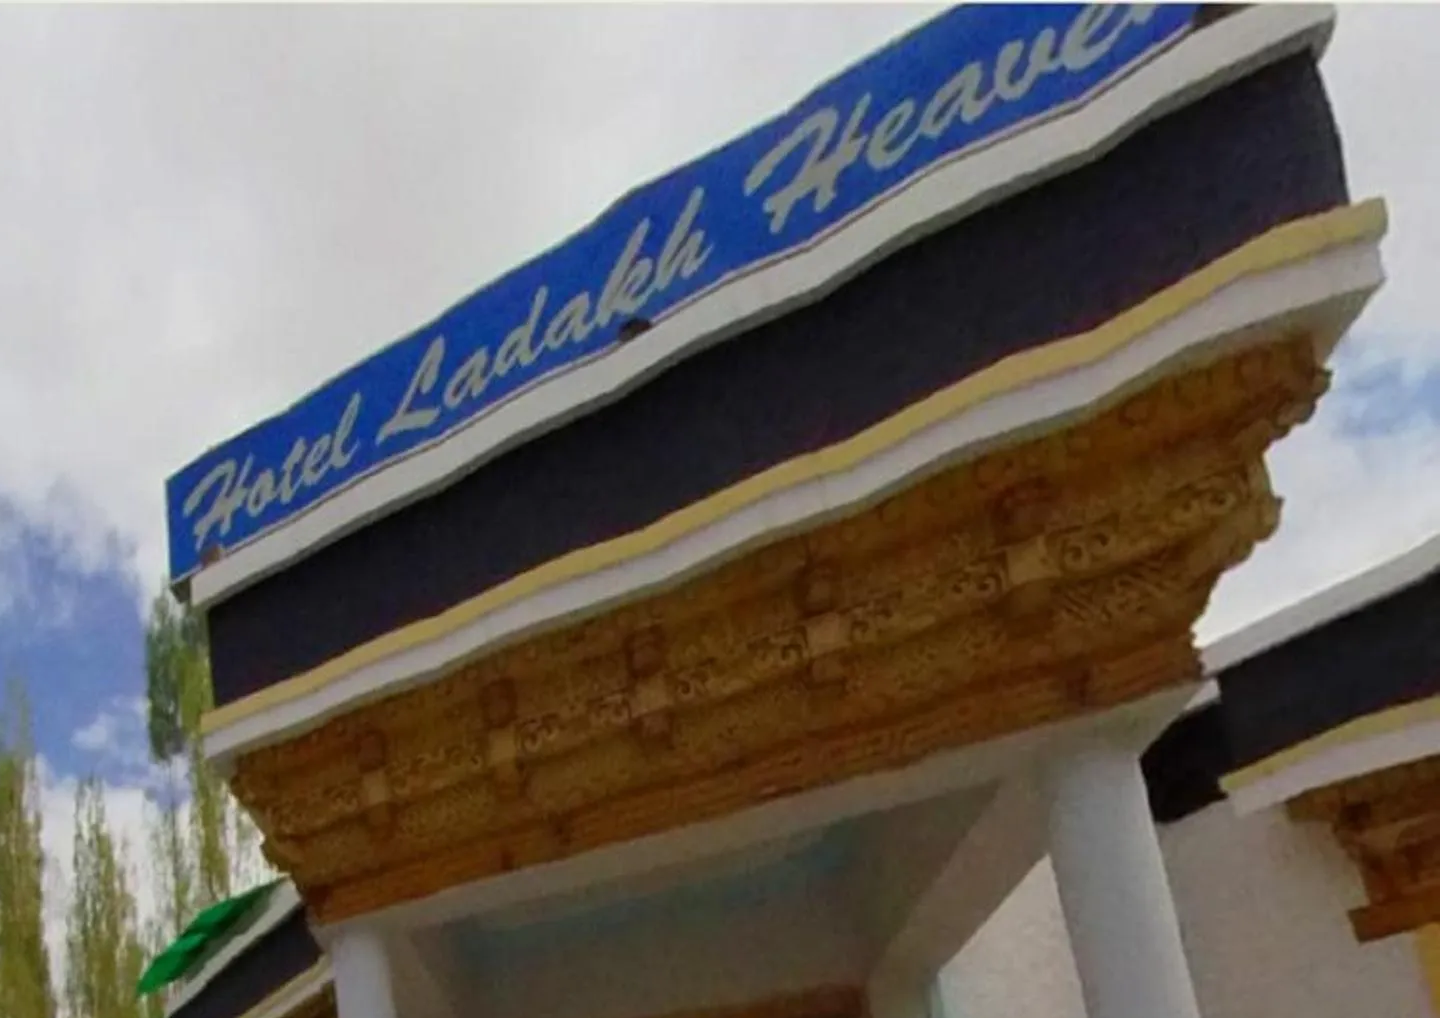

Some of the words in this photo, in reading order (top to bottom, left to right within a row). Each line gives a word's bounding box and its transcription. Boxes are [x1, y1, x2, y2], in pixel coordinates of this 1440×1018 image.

[182, 390, 361, 552] Hotel
[375, 186, 714, 445] Ladakh
[743, 3, 1157, 235] Heave
